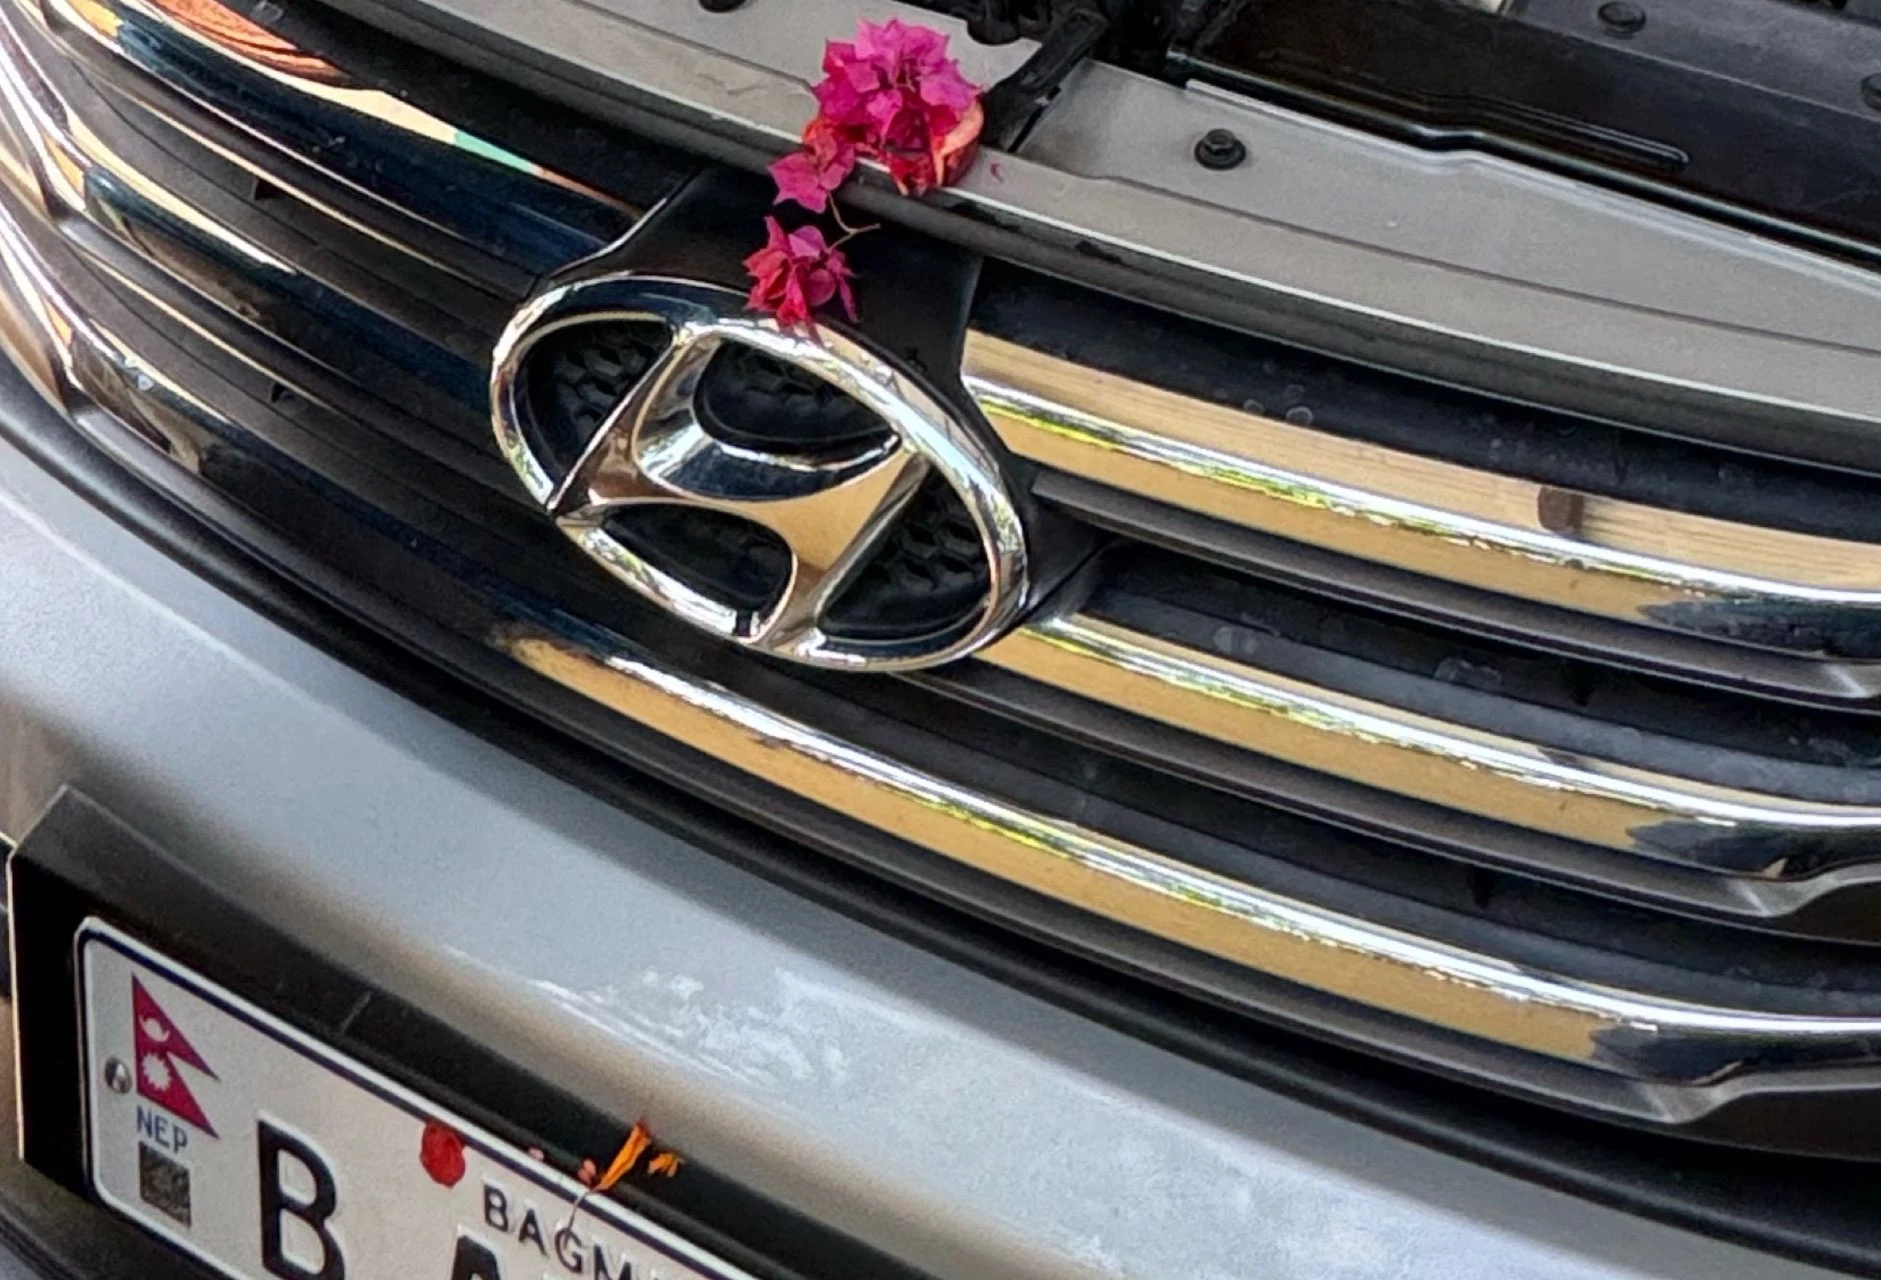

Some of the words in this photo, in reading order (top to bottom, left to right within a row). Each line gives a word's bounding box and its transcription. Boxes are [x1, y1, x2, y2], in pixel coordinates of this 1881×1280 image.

[137, 1104, 188, 1154] NEP
[257, 1115, 345, 1280] B
[483, 1183, 656, 1280] BAGM
